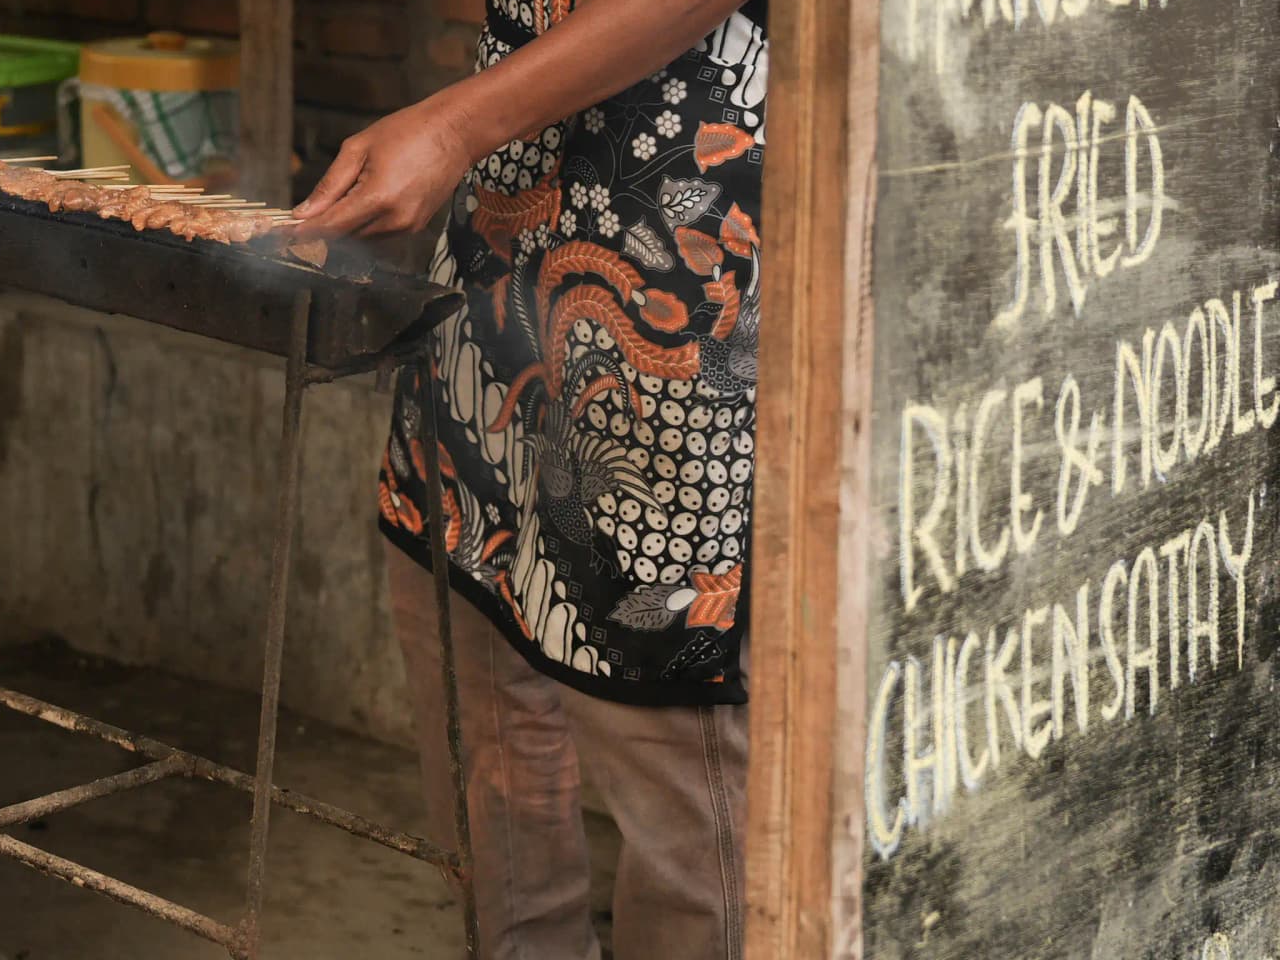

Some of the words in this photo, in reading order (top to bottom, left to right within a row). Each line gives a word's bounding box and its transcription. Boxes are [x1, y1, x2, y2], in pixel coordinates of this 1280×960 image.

[990, 88, 1165, 332] FRIED
[900, 377, 1044, 611] RICE
[1055, 372, 1105, 535] &
[1111, 280, 1280, 496] NOODLE
[865, 580, 1091, 861] CHICKEN
[1099, 487, 1256, 724] SATAY
